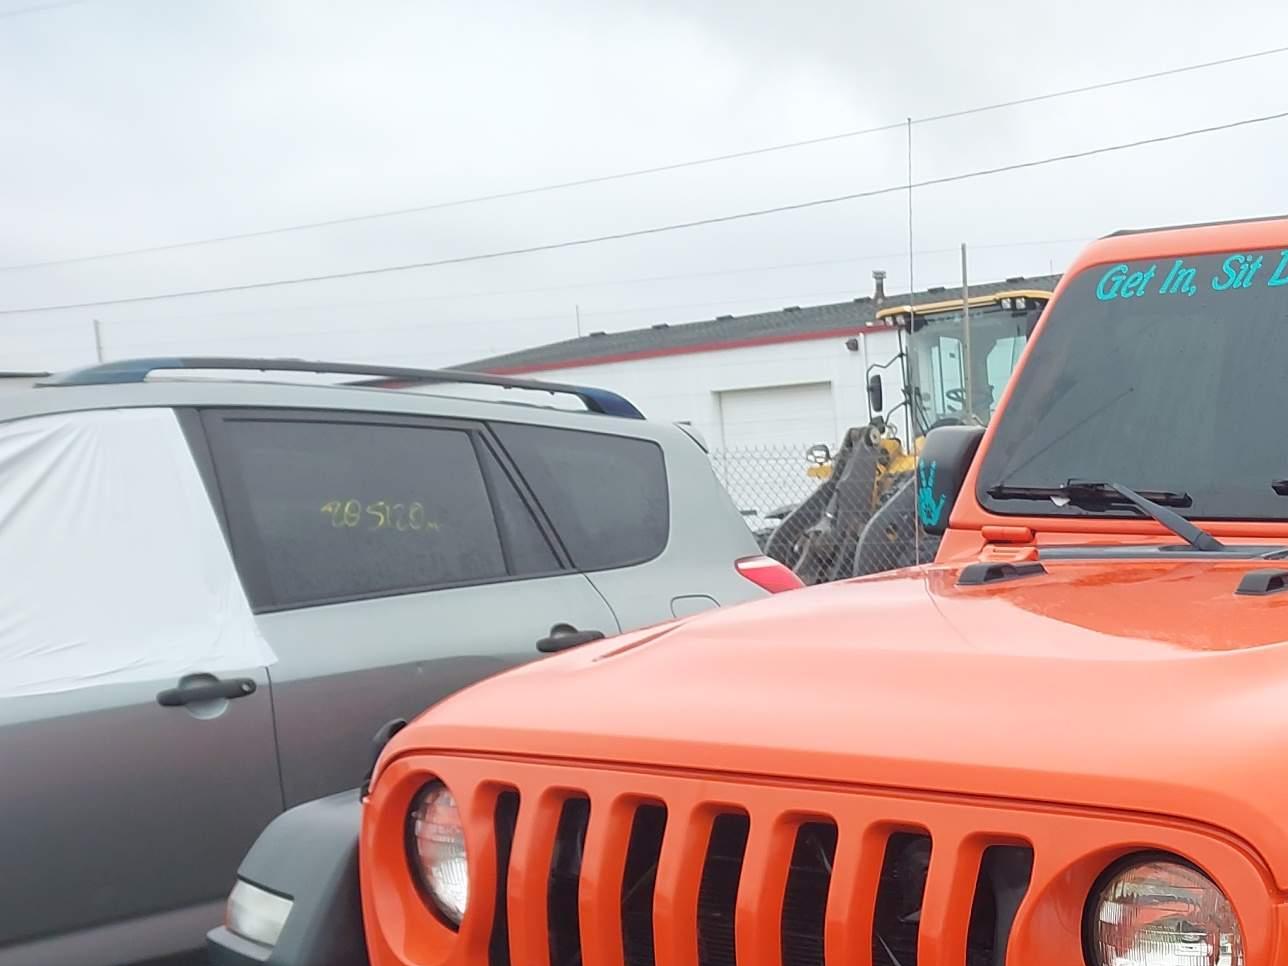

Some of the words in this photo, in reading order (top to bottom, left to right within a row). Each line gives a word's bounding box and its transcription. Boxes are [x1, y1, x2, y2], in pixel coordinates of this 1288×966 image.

[1096, 263, 1156, 300] Get
[1159, 259, 1197, 297] In,
[1211, 254, 1264, 292] Sit
